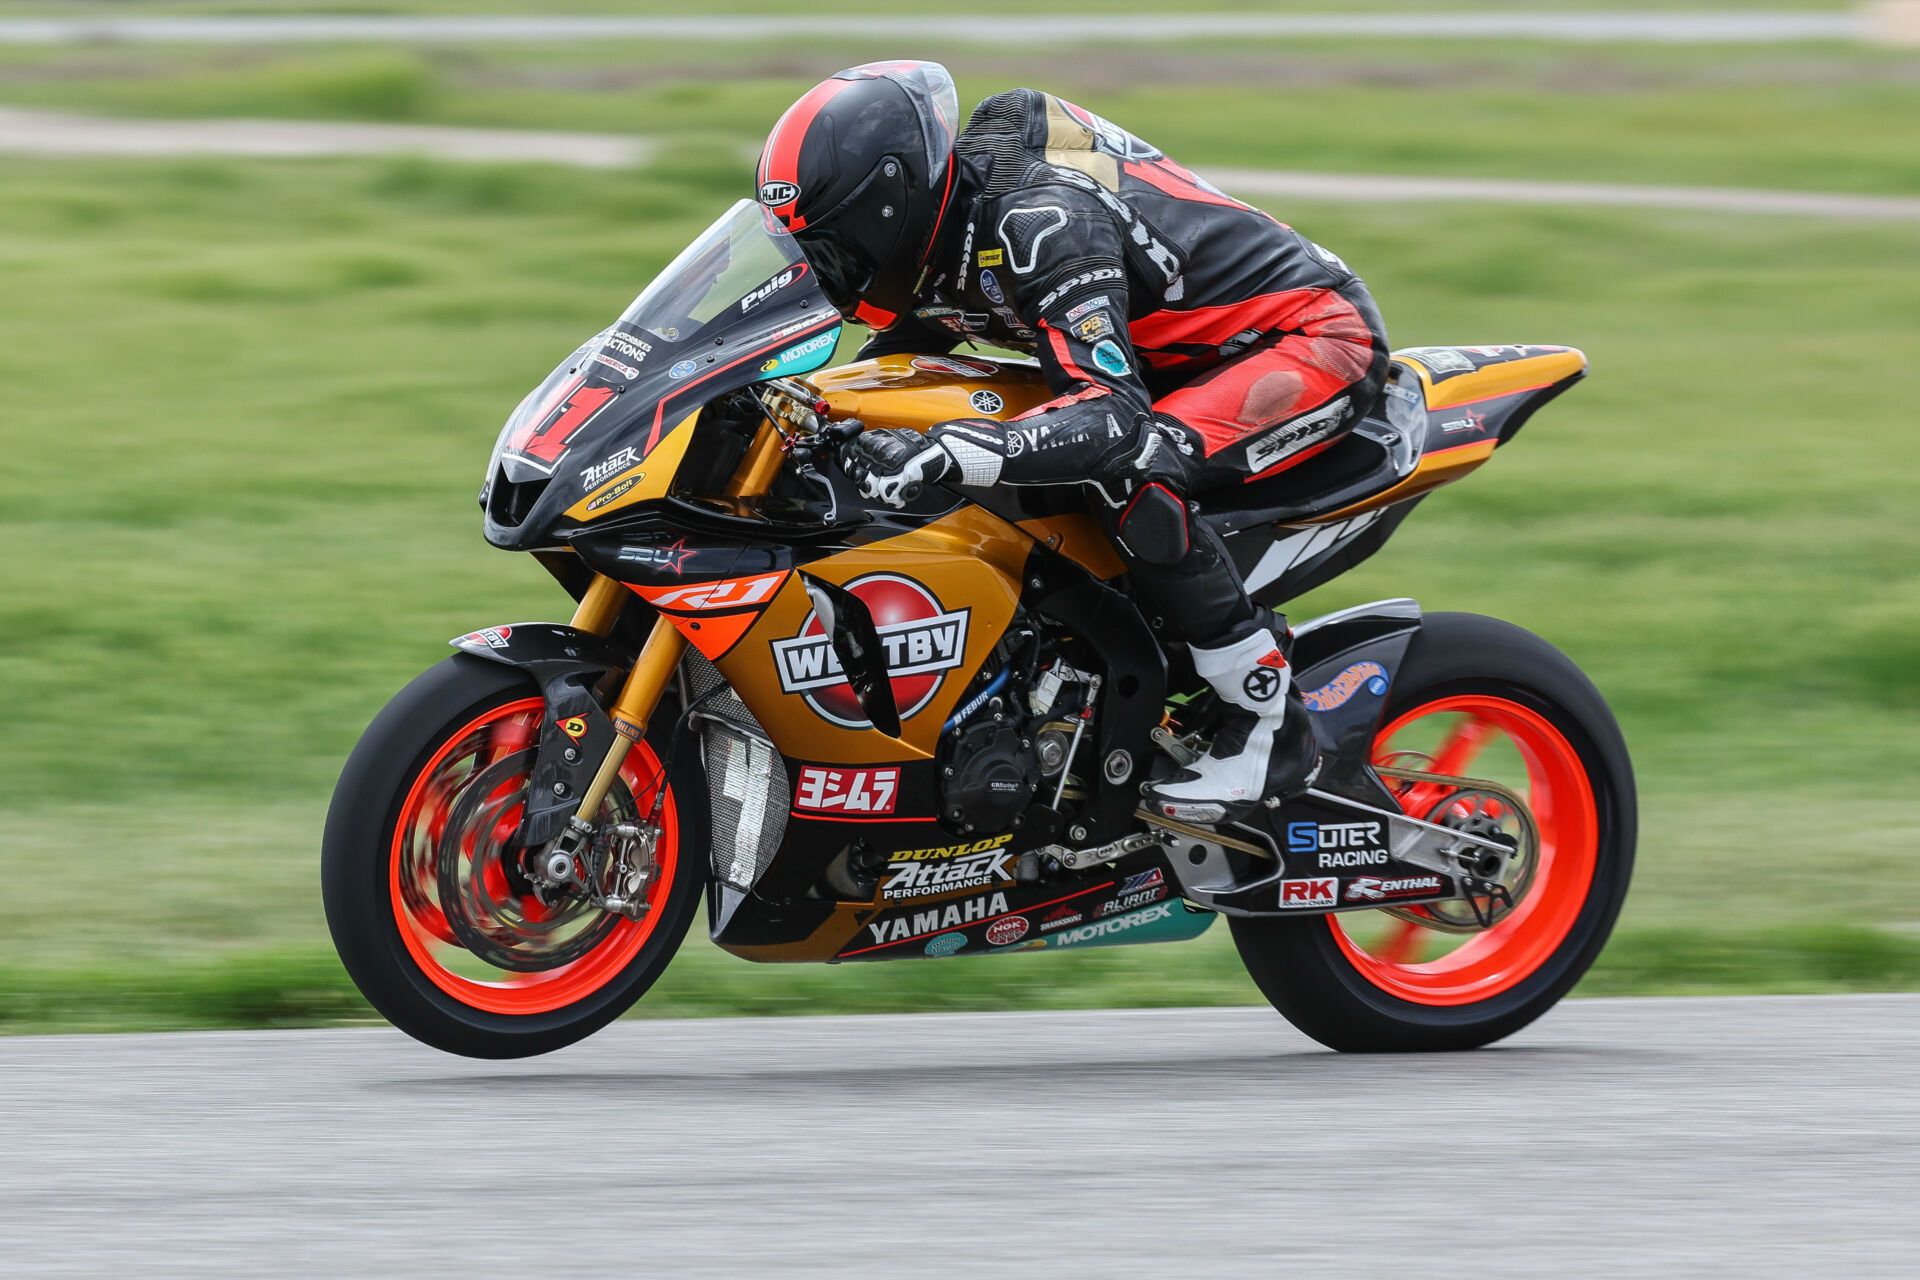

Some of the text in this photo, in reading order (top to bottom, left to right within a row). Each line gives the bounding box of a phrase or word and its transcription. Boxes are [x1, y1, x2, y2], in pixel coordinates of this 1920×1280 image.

[762, 186, 791, 201] HJC
[741, 270, 793, 311] Puig
[780, 332, 836, 364] MOTOREX
[580, 446, 642, 489] Attack
[584, 461, 632, 493] PERFORMANCE
[596, 479, 633, 506] Pro-Bolt
[650, 576, 780, 609] R1
[961, 691, 989, 719] FEBUR
[567, 721, 584, 732] D
[798, 769, 897, 811] ヨシムラ
[888, 833, 1014, 862] DUNLOP
[1287, 821, 1382, 853] SUTER
[882, 848, 1014, 890] Attack
[1318, 849, 1389, 869] RACING
[883, 875, 993, 900] PERFORMANCE
[1282, 879, 1335, 902] RK
[868, 892, 1009, 945] YAMAHA
[993, 920, 1021, 934] NGK
[1057, 902, 1173, 946] MOTOREX
